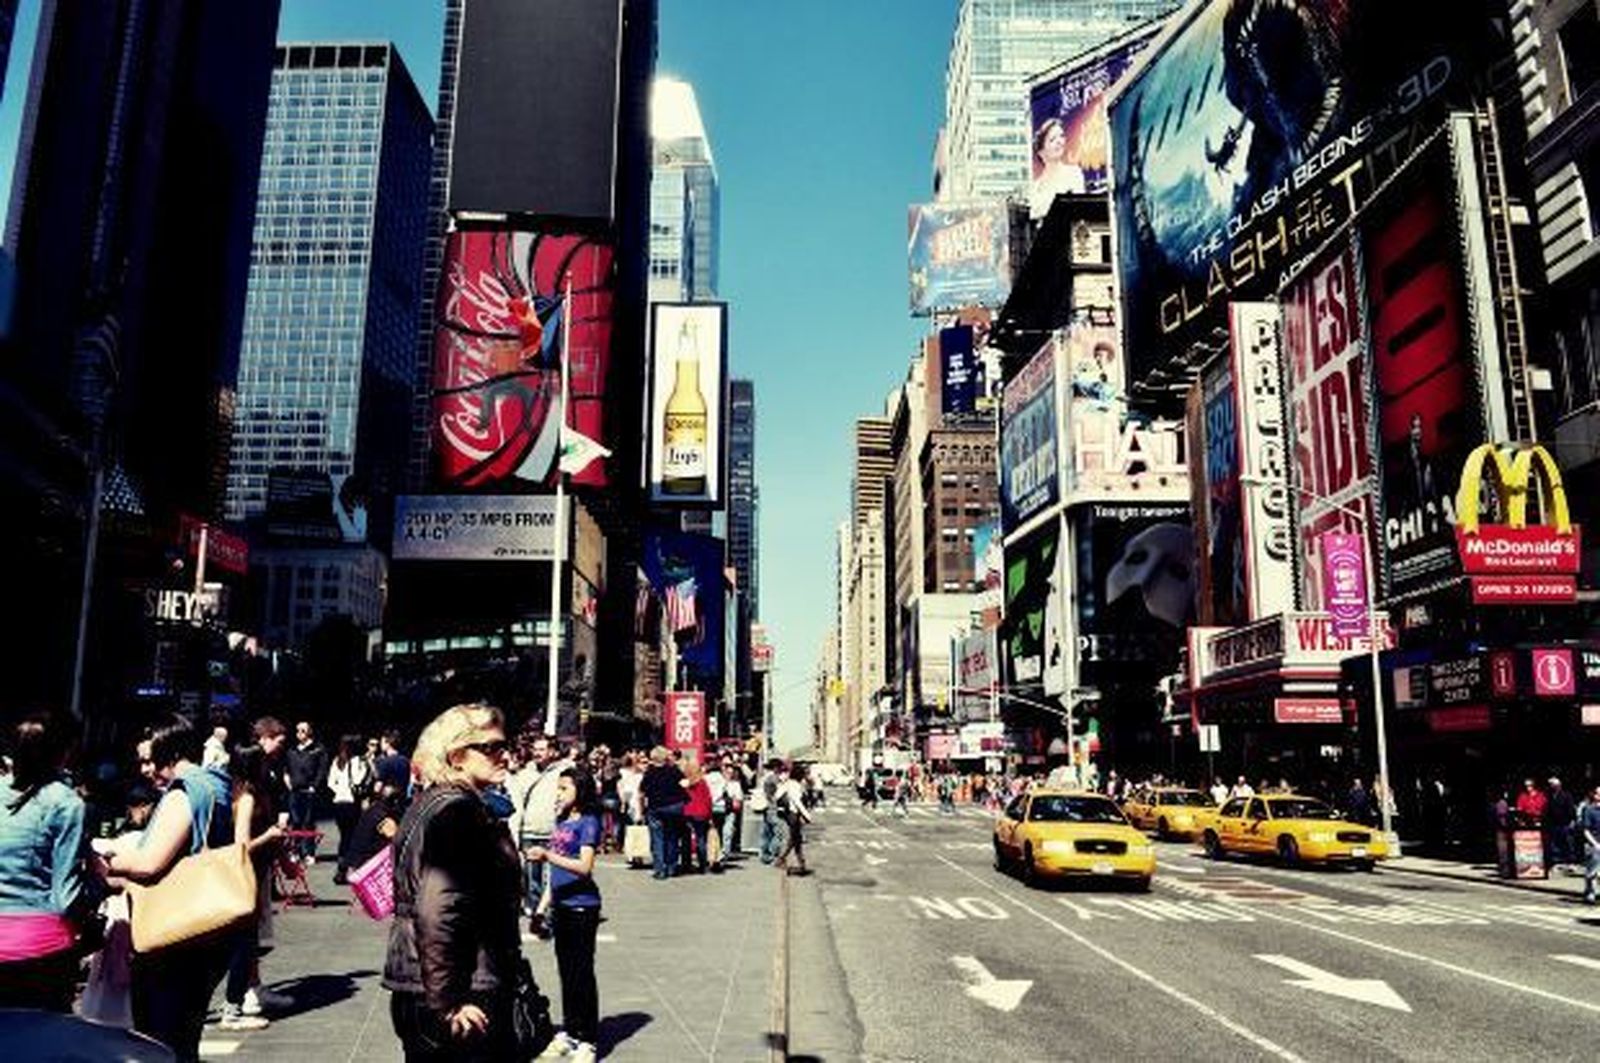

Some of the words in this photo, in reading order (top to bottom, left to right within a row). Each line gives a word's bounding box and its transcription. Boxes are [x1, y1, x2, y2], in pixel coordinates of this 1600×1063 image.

[1189, 229, 1224, 264] THE
[1226, 177, 1290, 240] CLASH
[1291, 115, 1375, 191] BEGINS
[1398, 55, 1451, 114] 3D
[1290, 202, 1336, 247] THE
[1159, 214, 1289, 334] CLASH
[461, 513, 478, 526] 35
[481, 513, 511, 527] MPG
[514, 513, 554, 527] FROM
[1466, 539, 1576, 555] McDonald's
[1513, 585, 1530, 596] 24
[1532, 585, 1574, 596] HOURS
[908, 897, 1010, 920] NO
